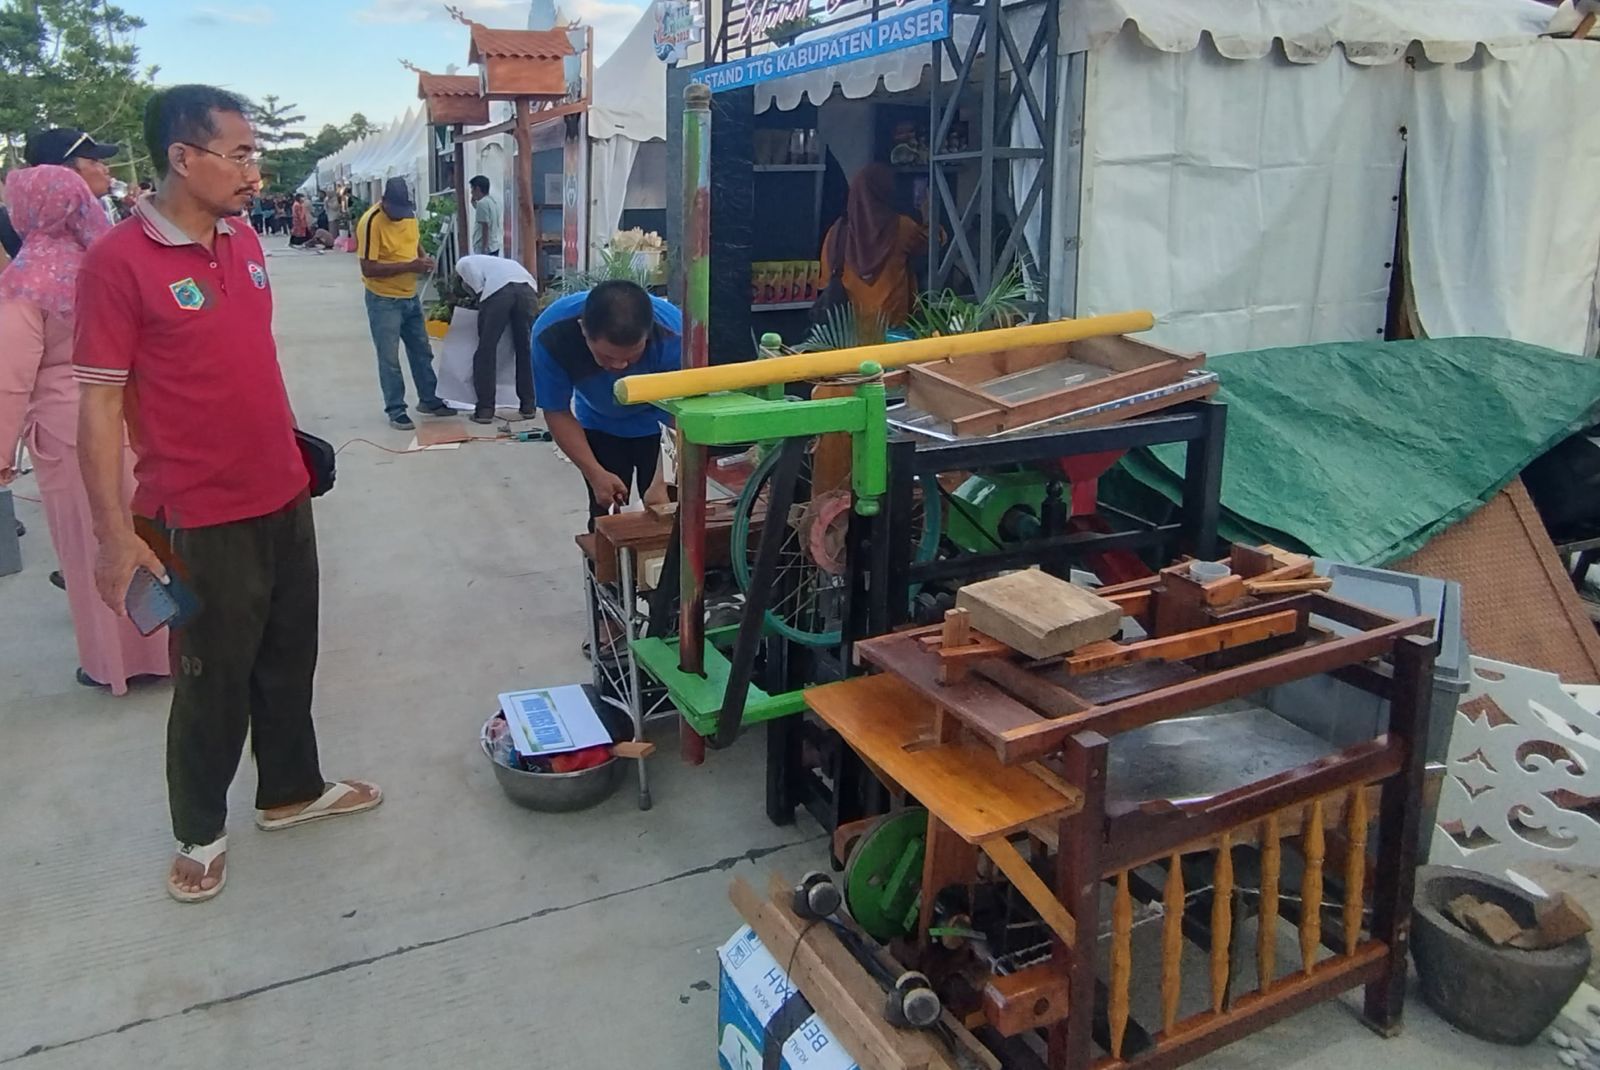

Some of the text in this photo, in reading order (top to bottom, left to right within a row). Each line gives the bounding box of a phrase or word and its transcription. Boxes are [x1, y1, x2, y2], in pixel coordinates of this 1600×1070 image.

[704, 65, 744, 88] STAND
[747, 57, 773, 79] TTG
[777, 28, 873, 72] KABUPATEN
[878, 9, 944, 46] PASER
